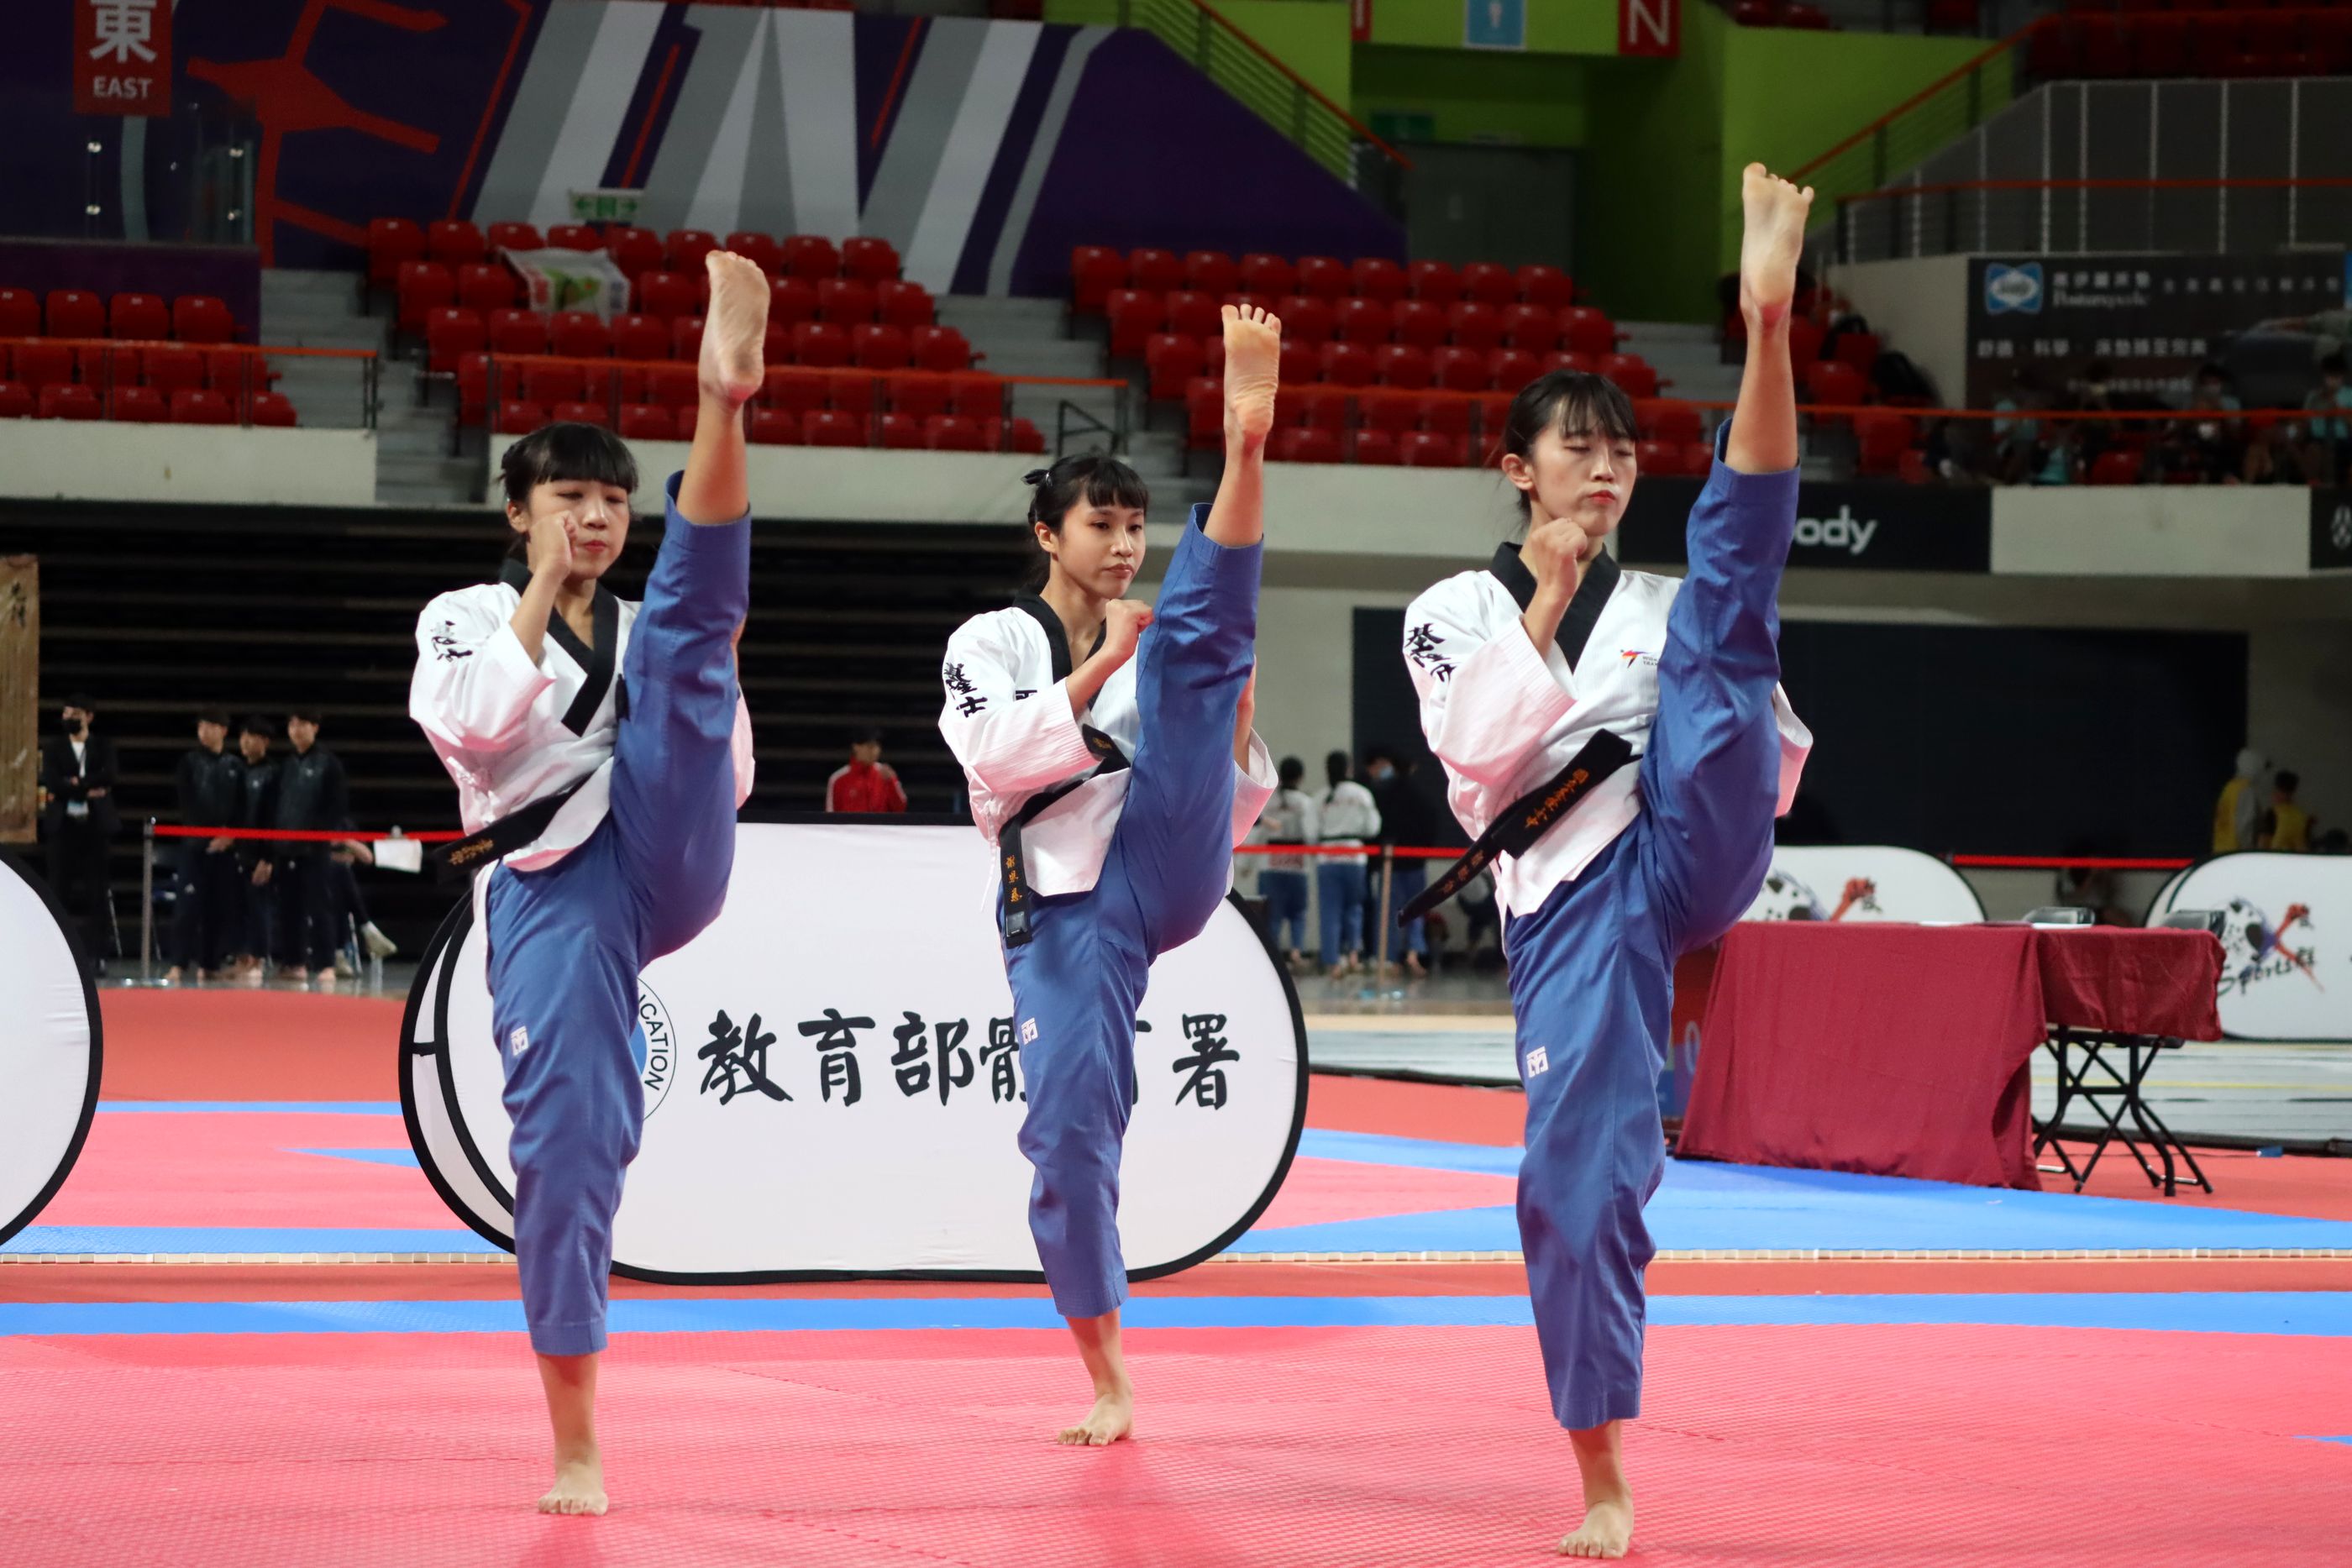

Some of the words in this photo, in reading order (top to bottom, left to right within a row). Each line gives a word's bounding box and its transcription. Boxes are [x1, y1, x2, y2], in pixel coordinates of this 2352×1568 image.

[89, 0, 157, 63] 東
[93, 76, 152, 99] EAST
[697, 1008, 1240, 1109] 教育部署
